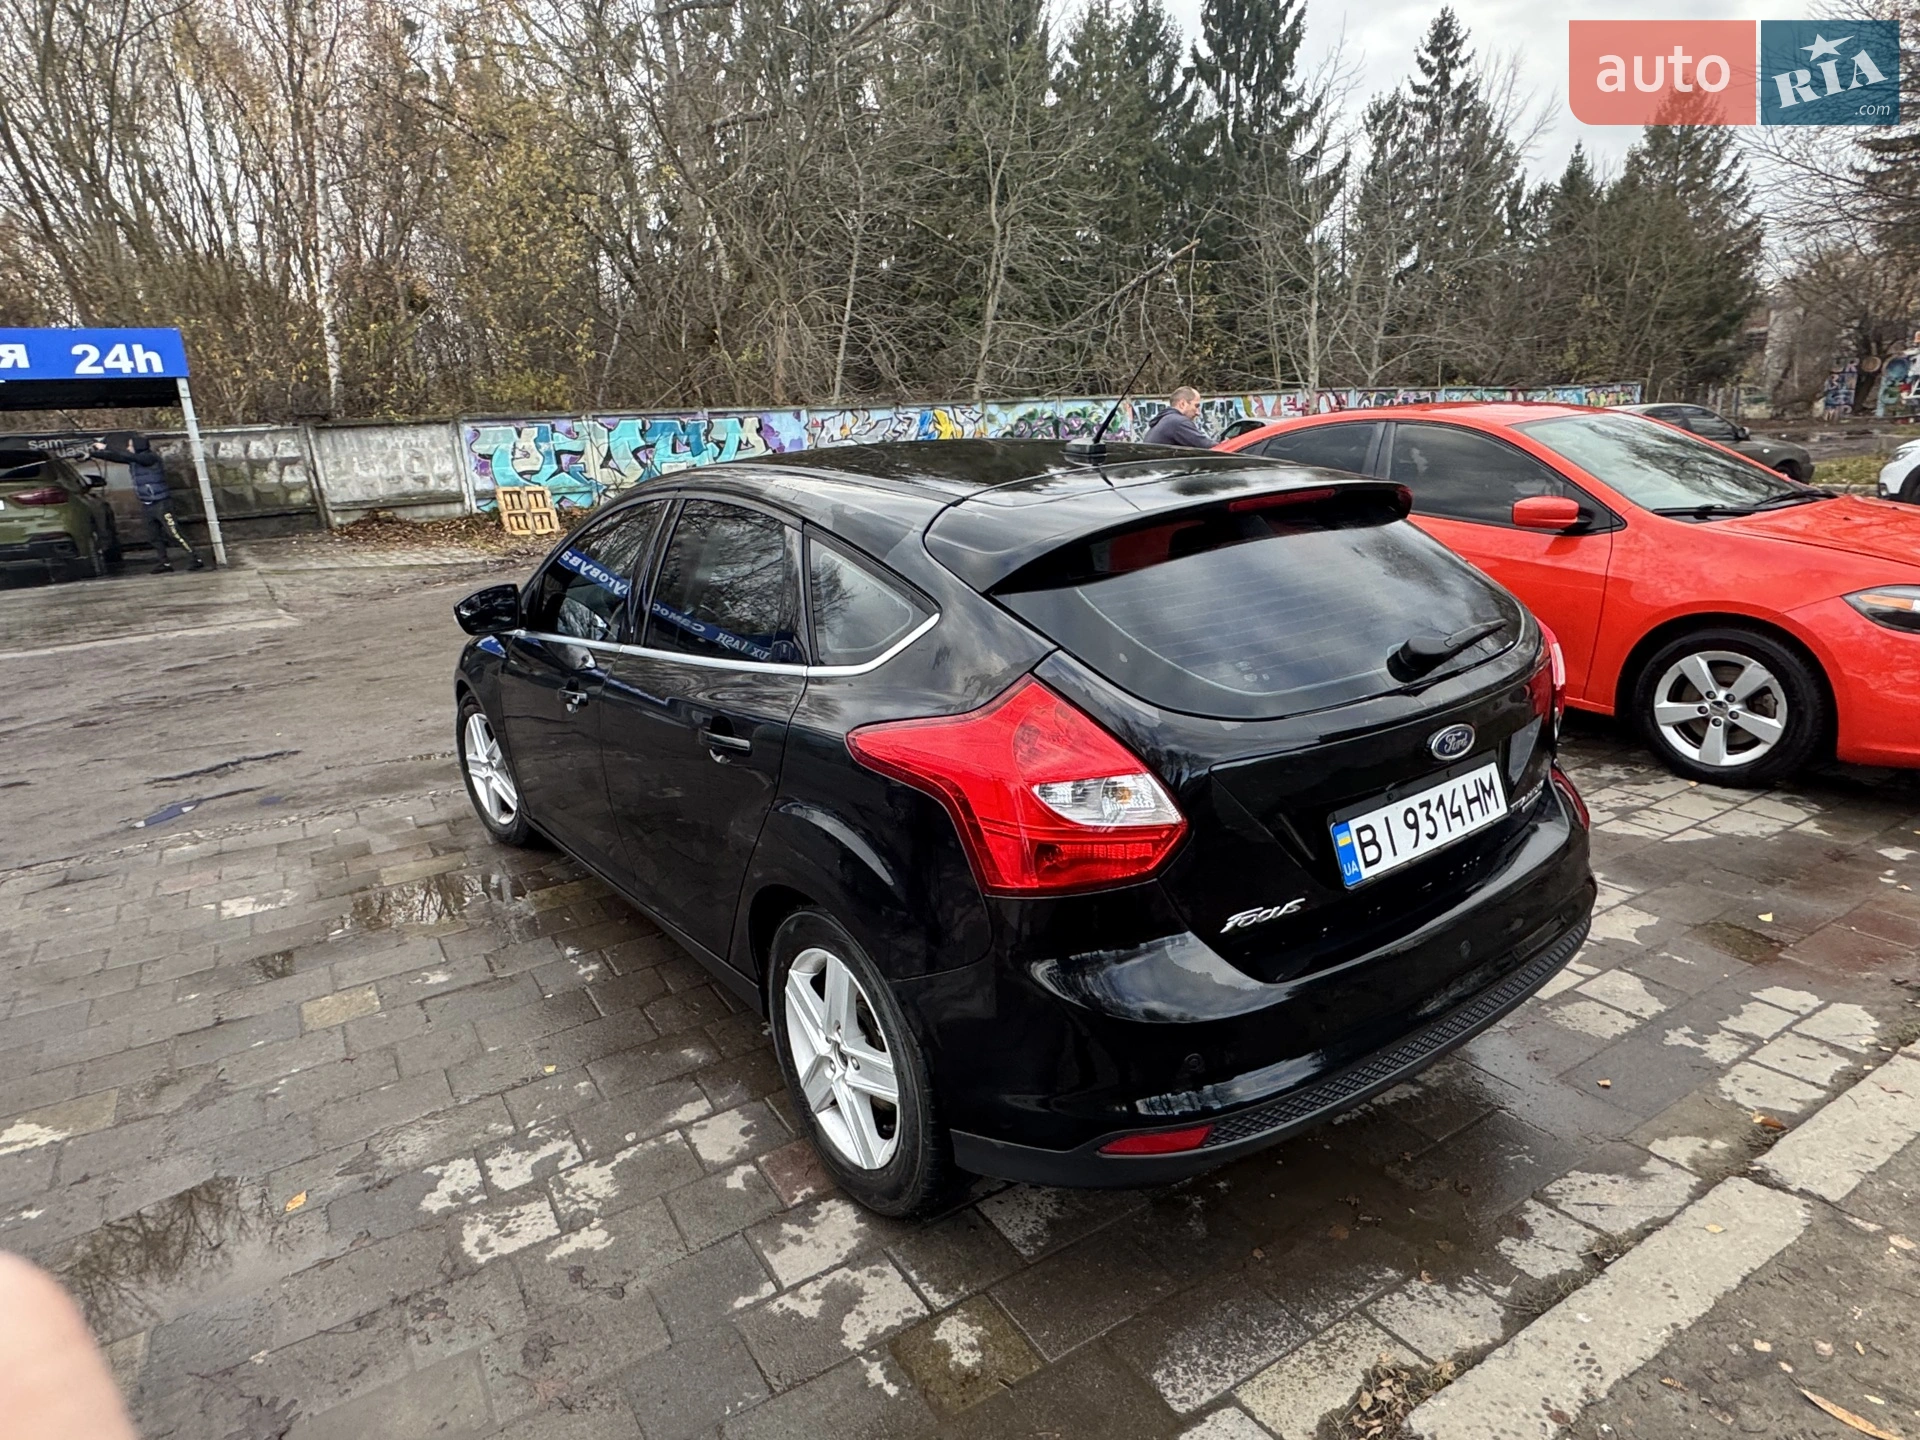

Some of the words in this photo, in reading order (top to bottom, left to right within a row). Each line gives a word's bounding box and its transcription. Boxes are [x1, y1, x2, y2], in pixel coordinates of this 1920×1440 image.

[71, 343, 165, 374] 24h
[1343, 860, 1359, 876] UA
[1355, 815, 1398, 869] BI
